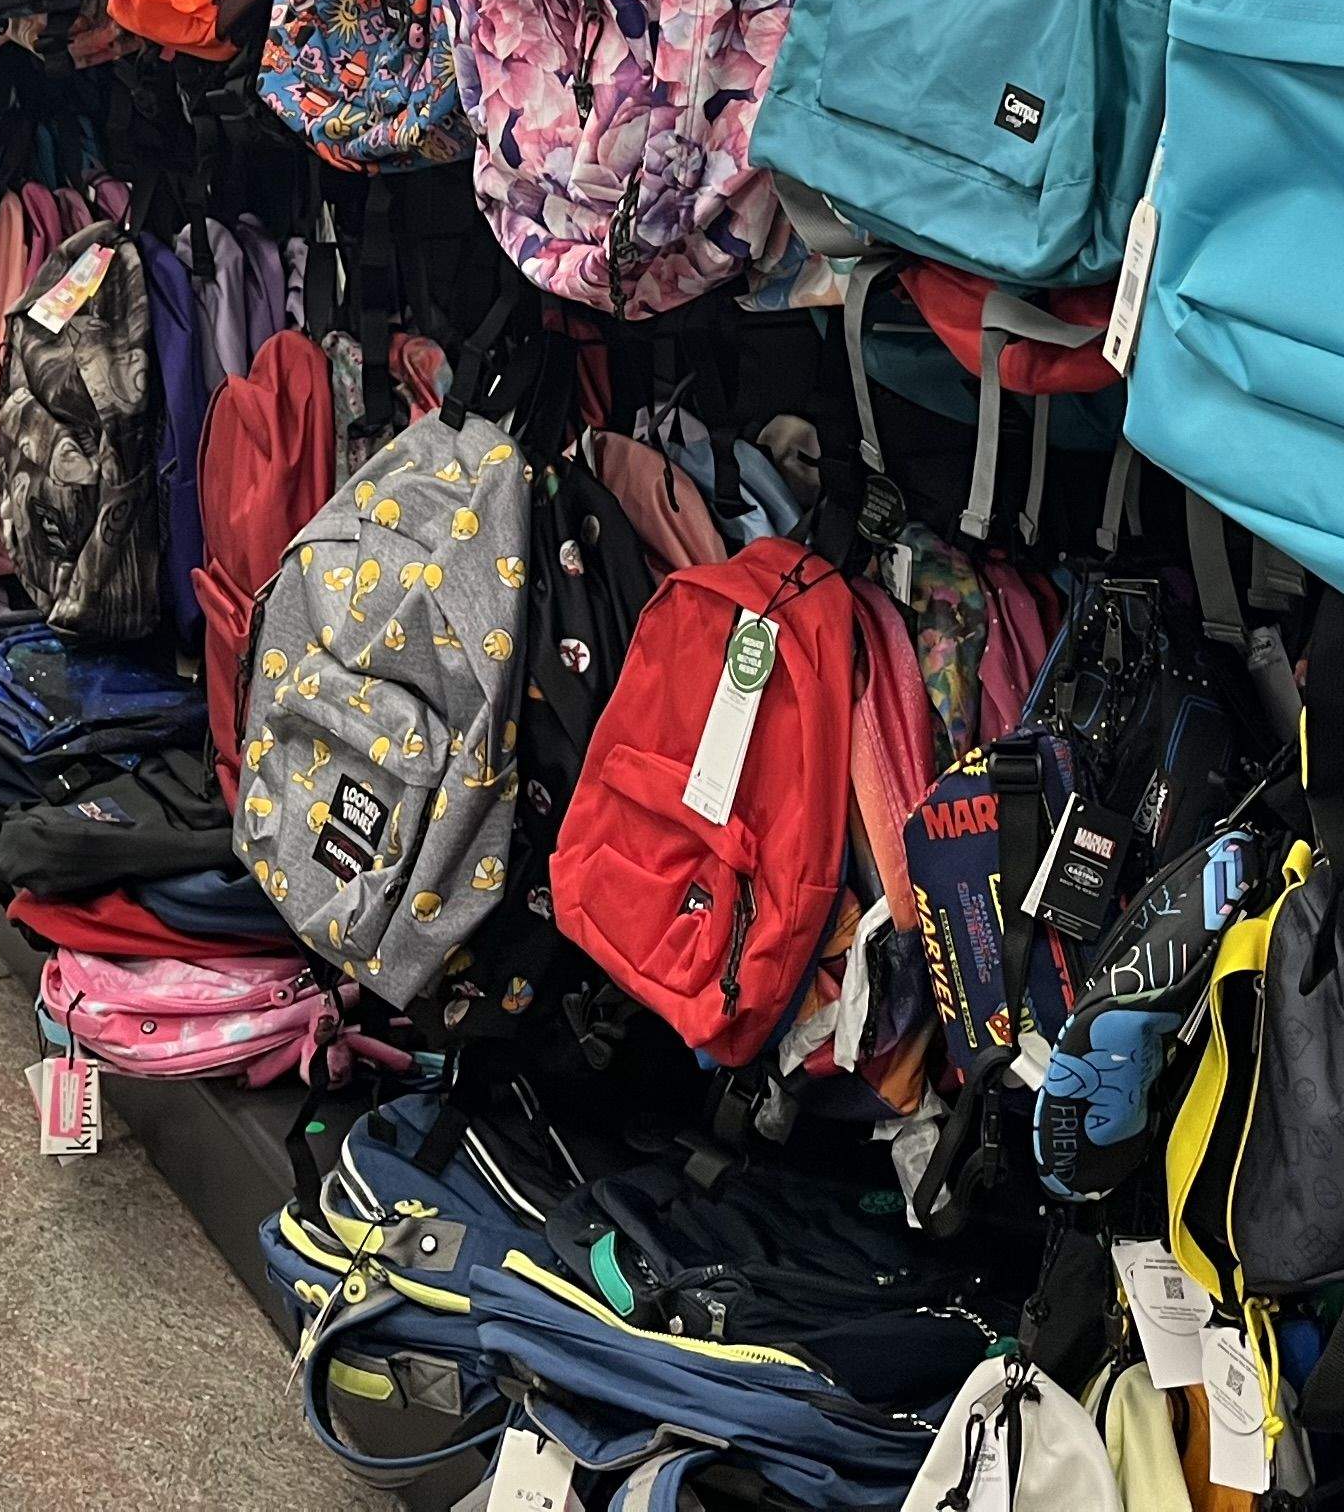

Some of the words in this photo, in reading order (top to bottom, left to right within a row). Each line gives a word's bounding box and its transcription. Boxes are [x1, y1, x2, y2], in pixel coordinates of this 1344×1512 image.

[1005, 93, 1039, 125] Campus
[342, 785, 382, 823] LOONEY
[342, 802, 376, 836] TUNES
[921, 793, 999, 840] MAR
[1074, 827, 1116, 859] MARVEL
[912, 883, 957, 1025] MARVEL
[1049, 1104, 1078, 1183] FRIEND
